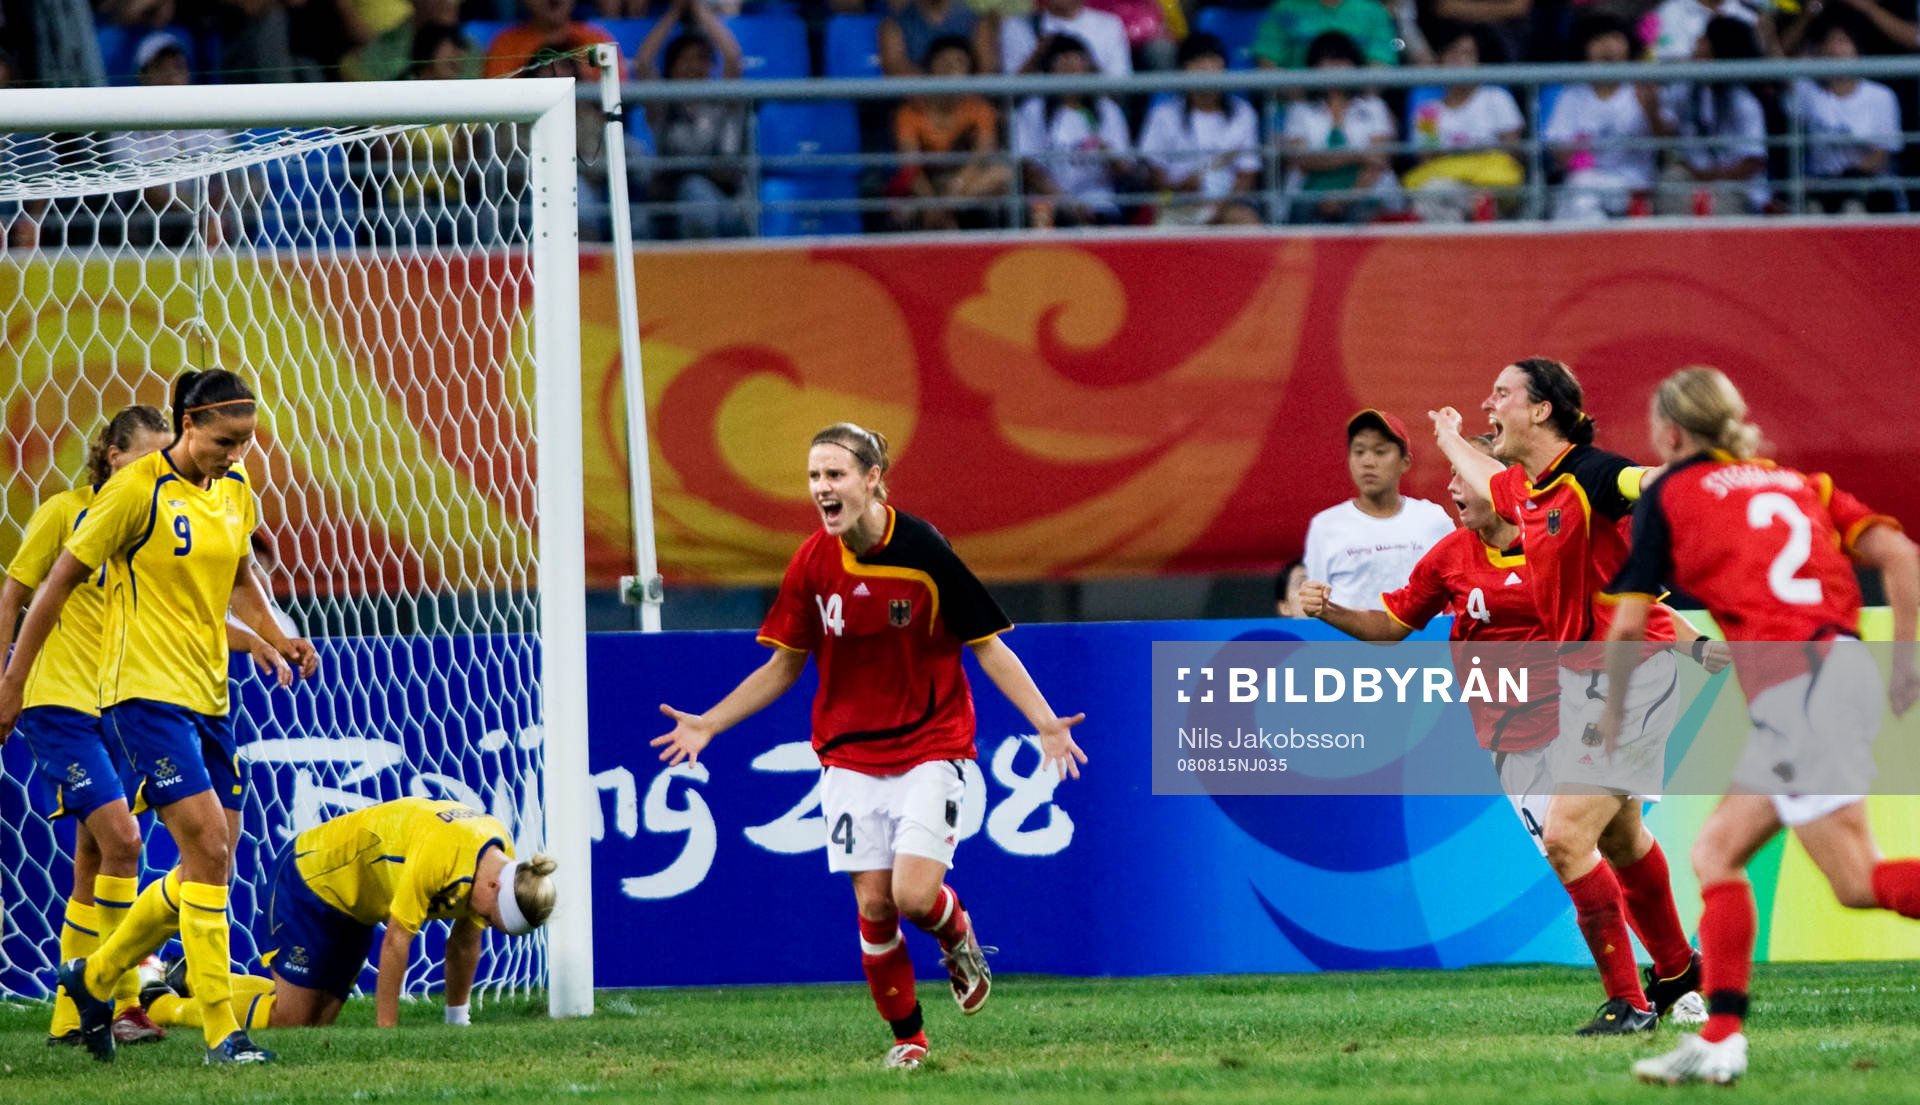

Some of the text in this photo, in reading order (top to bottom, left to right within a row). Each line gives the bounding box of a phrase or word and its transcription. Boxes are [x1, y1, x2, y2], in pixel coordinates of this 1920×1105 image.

[173, 514, 192, 556] 9
[1746, 491, 1823, 605] 2
[815, 593, 845, 637] 14
[1466, 587, 1491, 624] 4
[155, 774, 183, 789] SWE
[744, 734, 1074, 856] 28
[825, 812, 856, 854] 4
